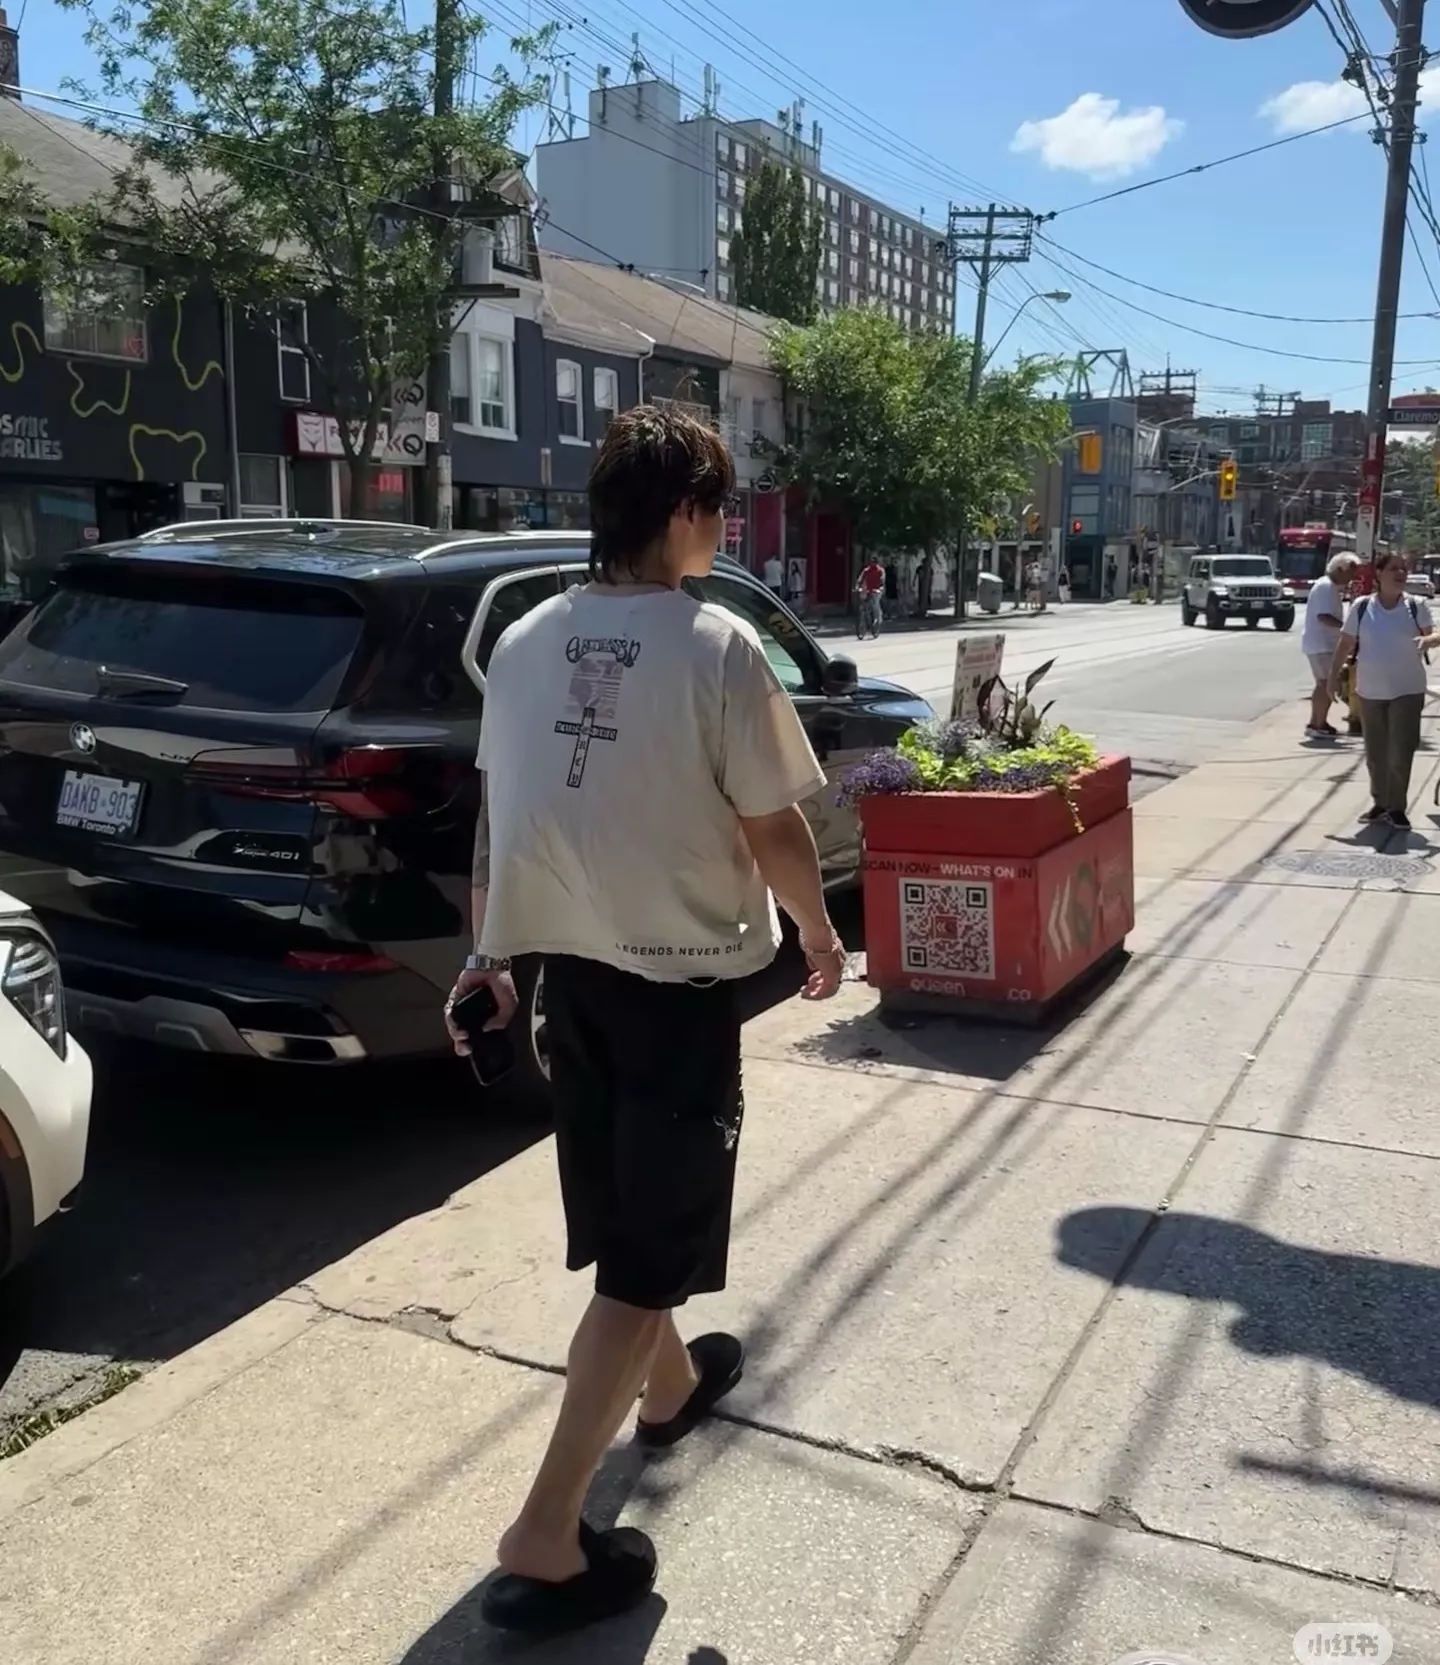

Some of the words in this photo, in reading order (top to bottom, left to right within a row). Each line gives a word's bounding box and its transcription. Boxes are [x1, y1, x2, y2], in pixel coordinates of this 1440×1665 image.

[994, 866, 1015, 879] ON
[615, 942, 673, 956] LEGENDS
[679, 946, 720, 956] NEVER
[725, 941, 743, 954] DIE
